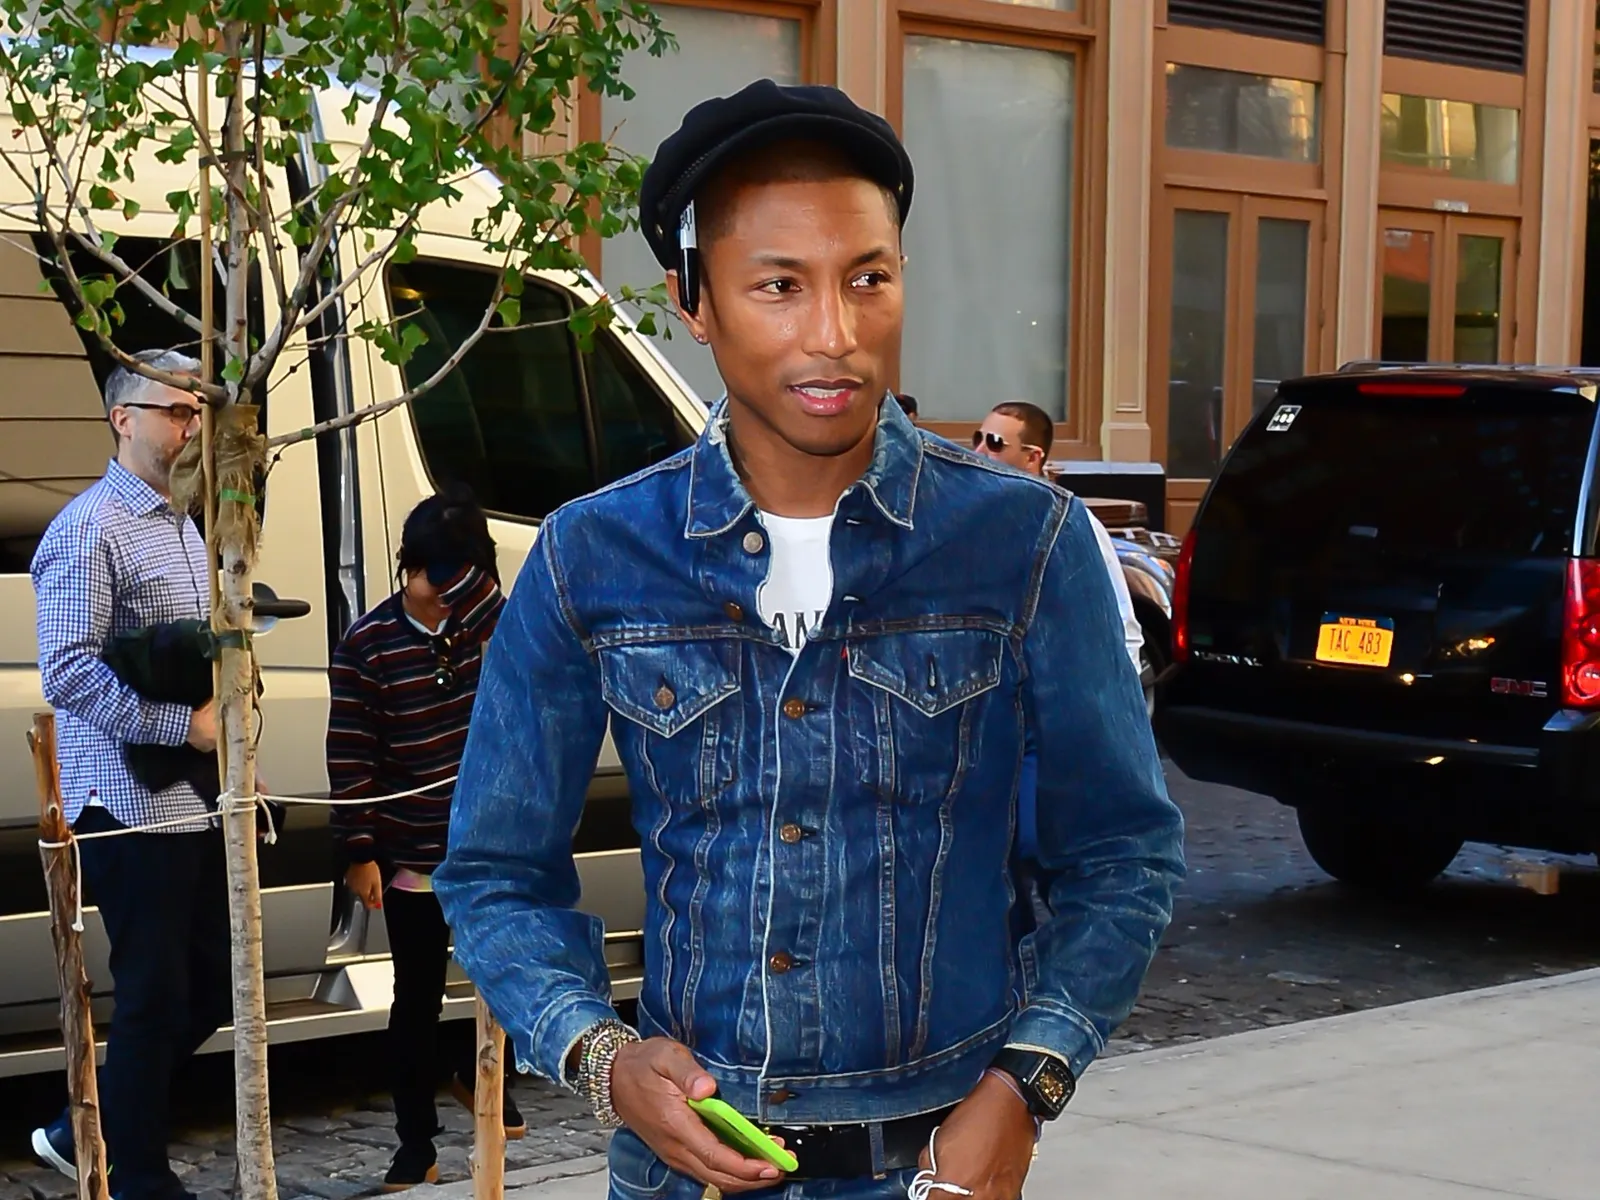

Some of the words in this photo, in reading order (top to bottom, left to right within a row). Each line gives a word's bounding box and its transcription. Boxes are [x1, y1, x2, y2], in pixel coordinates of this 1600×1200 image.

[1329, 627, 1352, 652] TAC
[1358, 631, 1382, 655] 483
[1490, 677, 1548, 698] GMC
